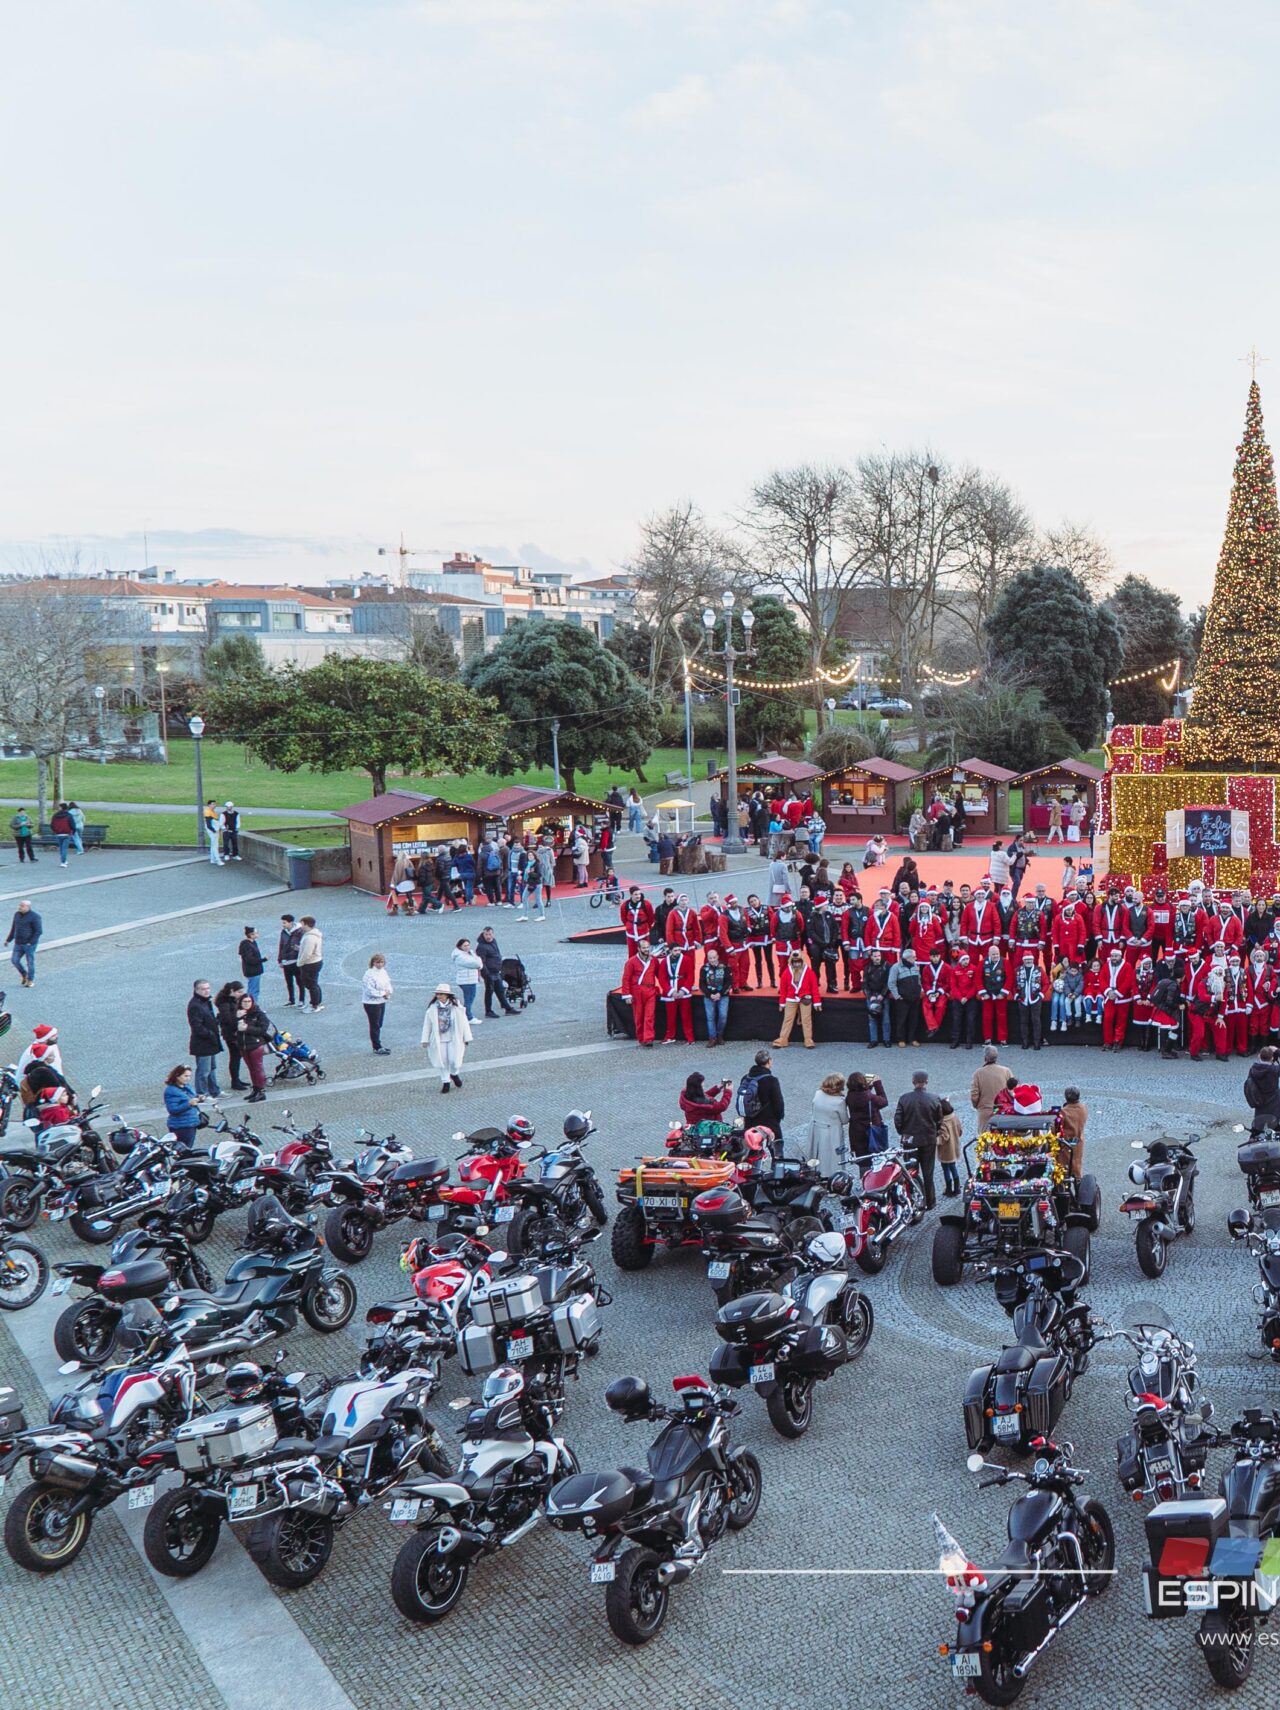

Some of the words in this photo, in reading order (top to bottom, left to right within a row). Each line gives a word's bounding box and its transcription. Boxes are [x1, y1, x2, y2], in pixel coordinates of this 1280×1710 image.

[644, 1197, 655, 1206] 70
[514, 1340, 526, 1348] AH
[138, 1488, 147, 1496] 24
[962, 1655, 971, 1664] AI
